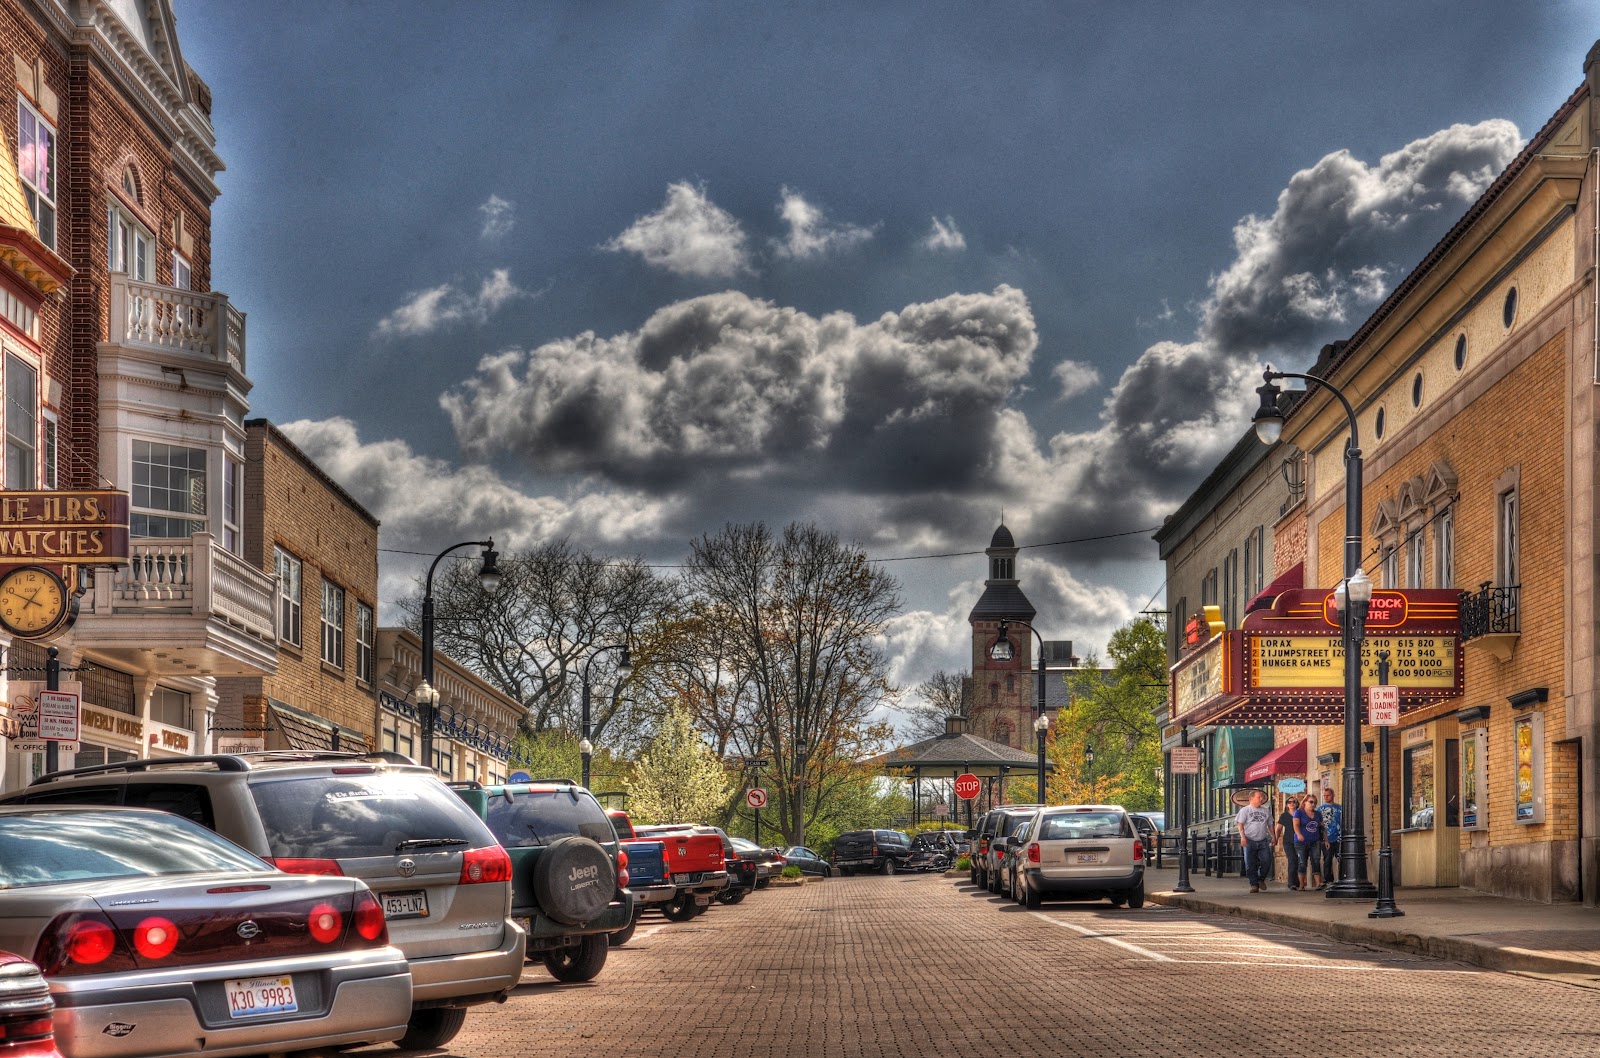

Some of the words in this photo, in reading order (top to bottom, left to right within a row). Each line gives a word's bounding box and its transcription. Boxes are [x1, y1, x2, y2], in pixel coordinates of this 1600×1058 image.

[1260, 640, 1292, 648] LORAX
[1374, 640, 1390, 648] 410
[1398, 640, 1414, 648] 615
[1418, 640, 1434, 648] 820
[1262, 660, 1298, 668] HUNGER
[1300, 660, 1330, 668] GAMES
[1393, 669, 1410, 677] 600
[1414, 669, 1432, 677] 900
[1372, 702, 1396, 710] LOADING
[1376, 712, 1392, 720] ZONE
[162, 728, 188, 750] TAVERN
[956, 781, 978, 792] STOP
[569, 865, 598, 881] Jeep
[571, 879, 599, 890] LIBERTY
[387, 898, 424, 913] 453-LNZ
[250, 980, 277, 988] Illinois
[230, 990, 255, 1010] K30
[262, 987, 293, 1007] 9983
